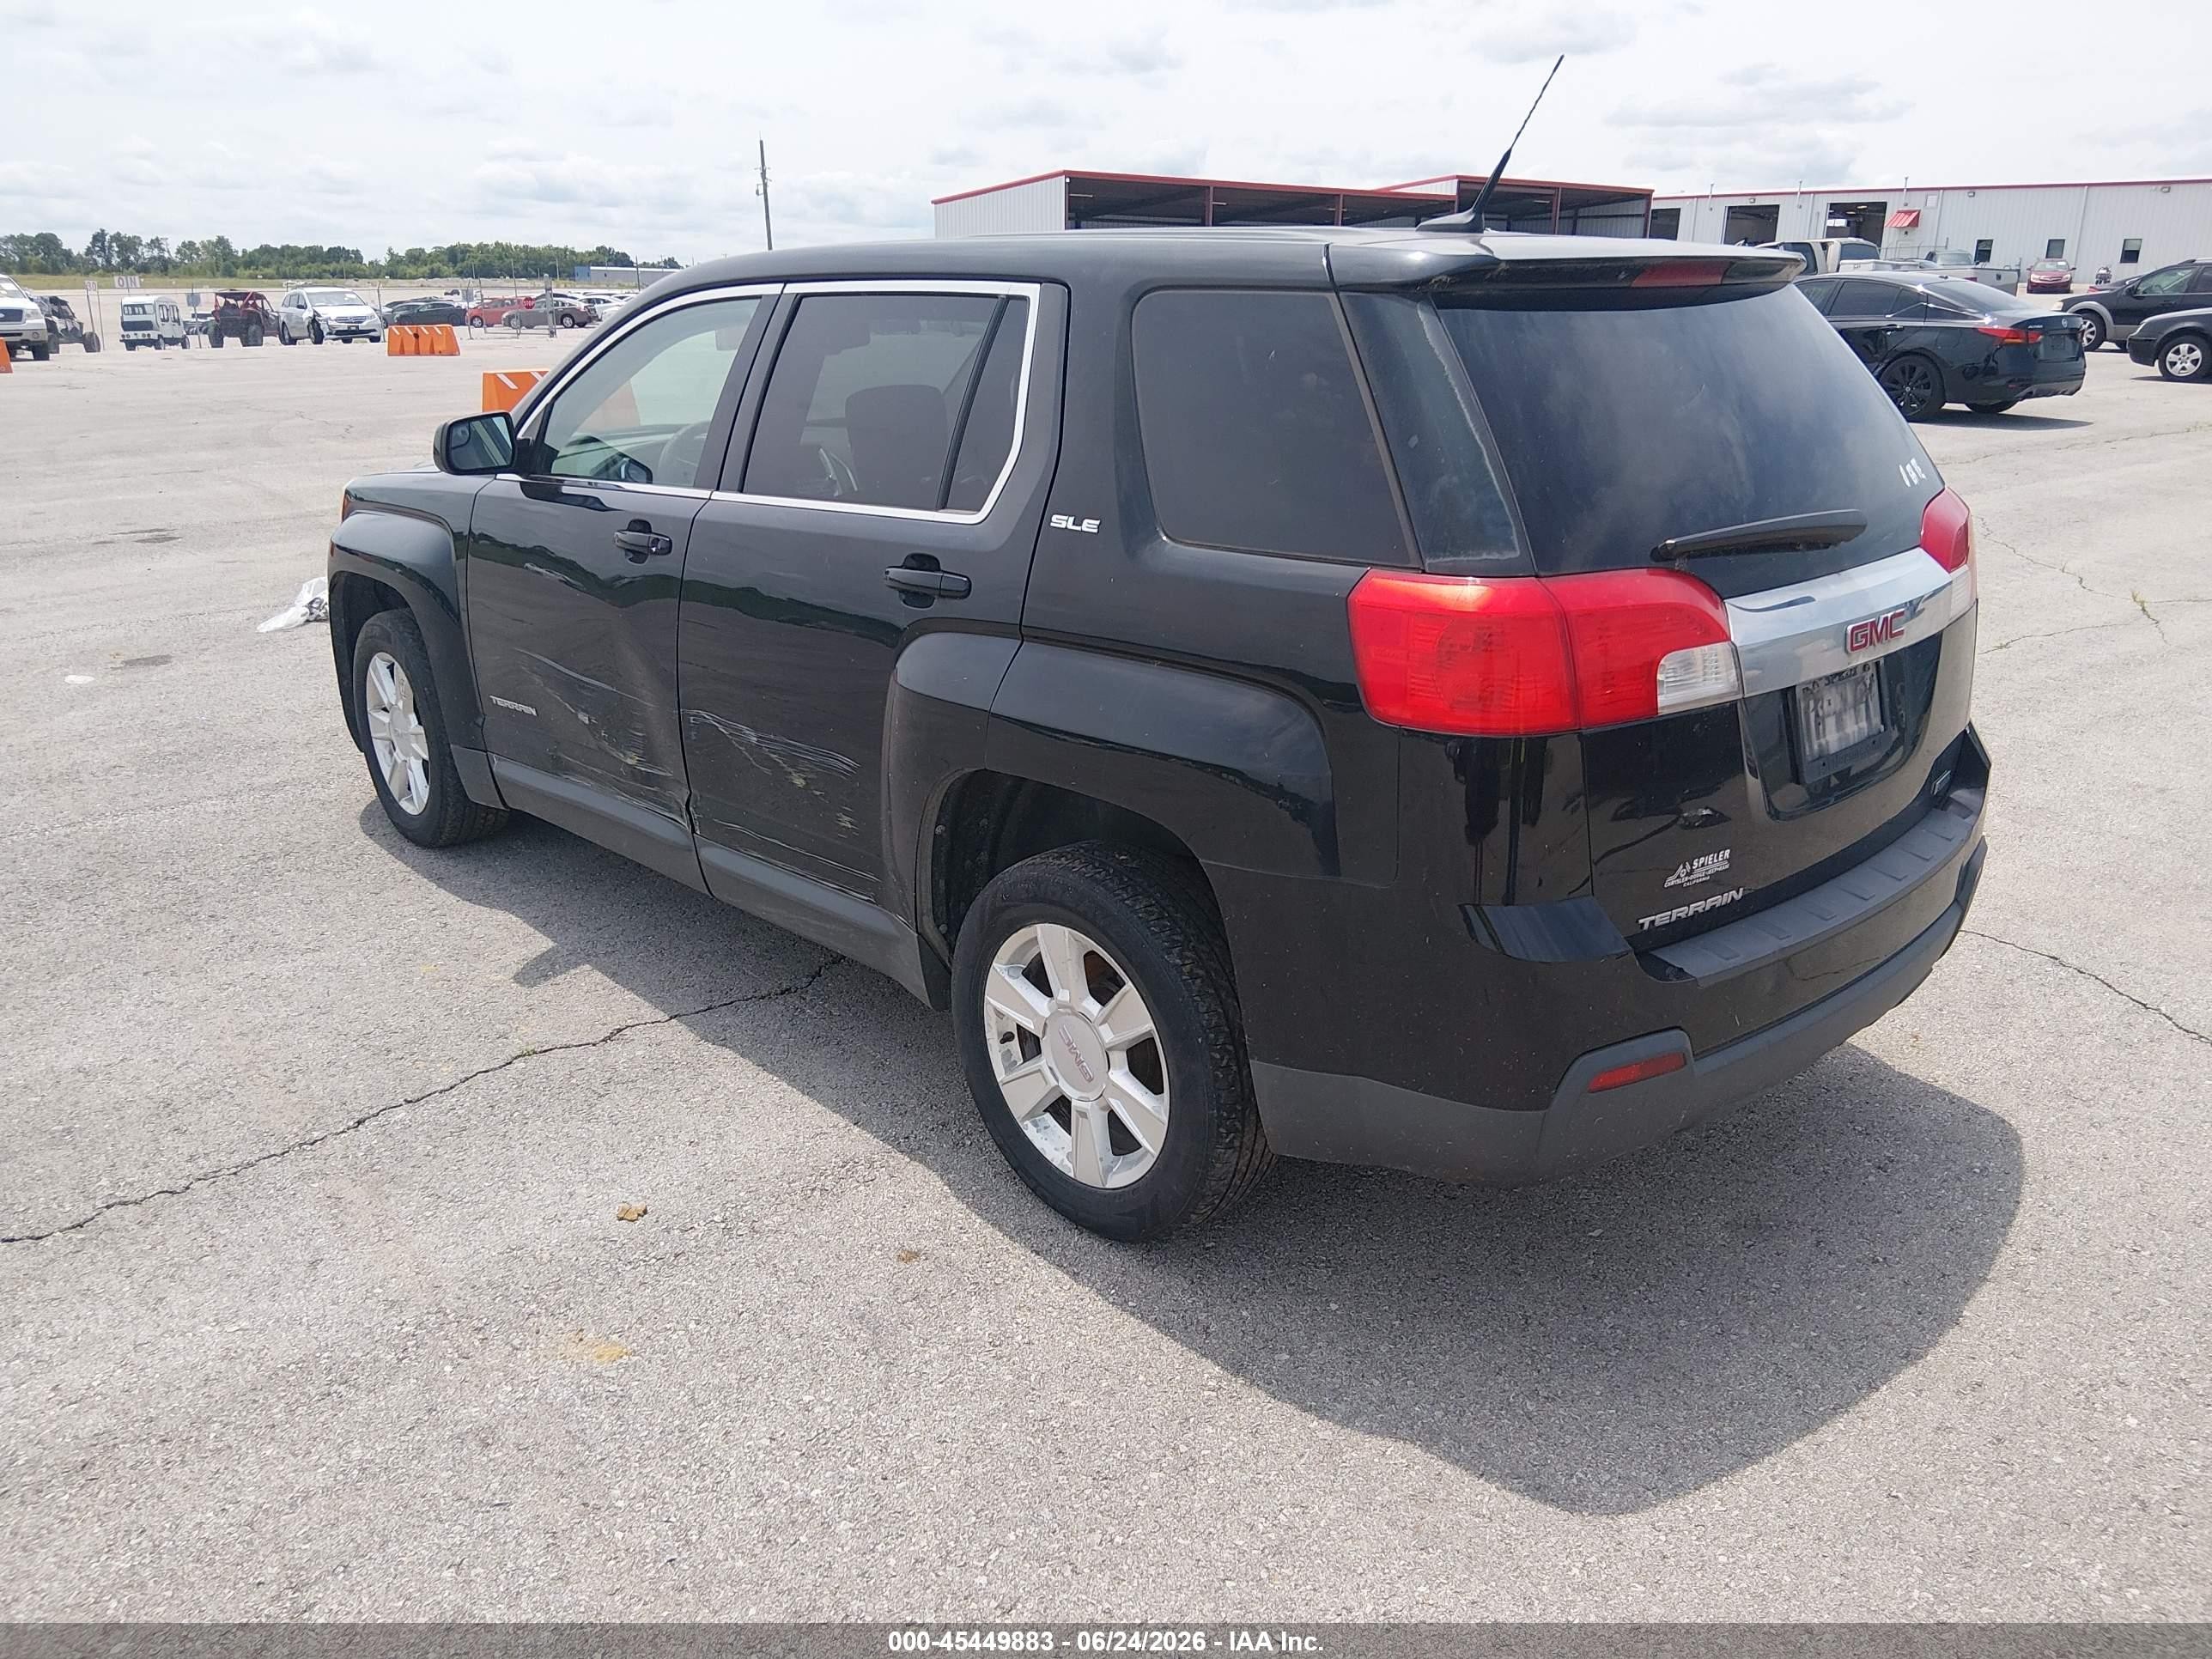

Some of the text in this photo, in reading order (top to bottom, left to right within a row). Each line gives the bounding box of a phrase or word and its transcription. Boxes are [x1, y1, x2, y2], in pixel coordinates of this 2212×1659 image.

[1050, 514, 1101, 533] SLE
[1847, 608, 1905, 653] GMC
[489, 695, 538, 717] TERRAIN
[1692, 849, 1731, 870] SPIELER
[1683, 876, 1711, 888] CALIFORNIA
[1638, 887, 1744, 931] TERRAIN
[1058, 1024, 1094, 1083] GMC
